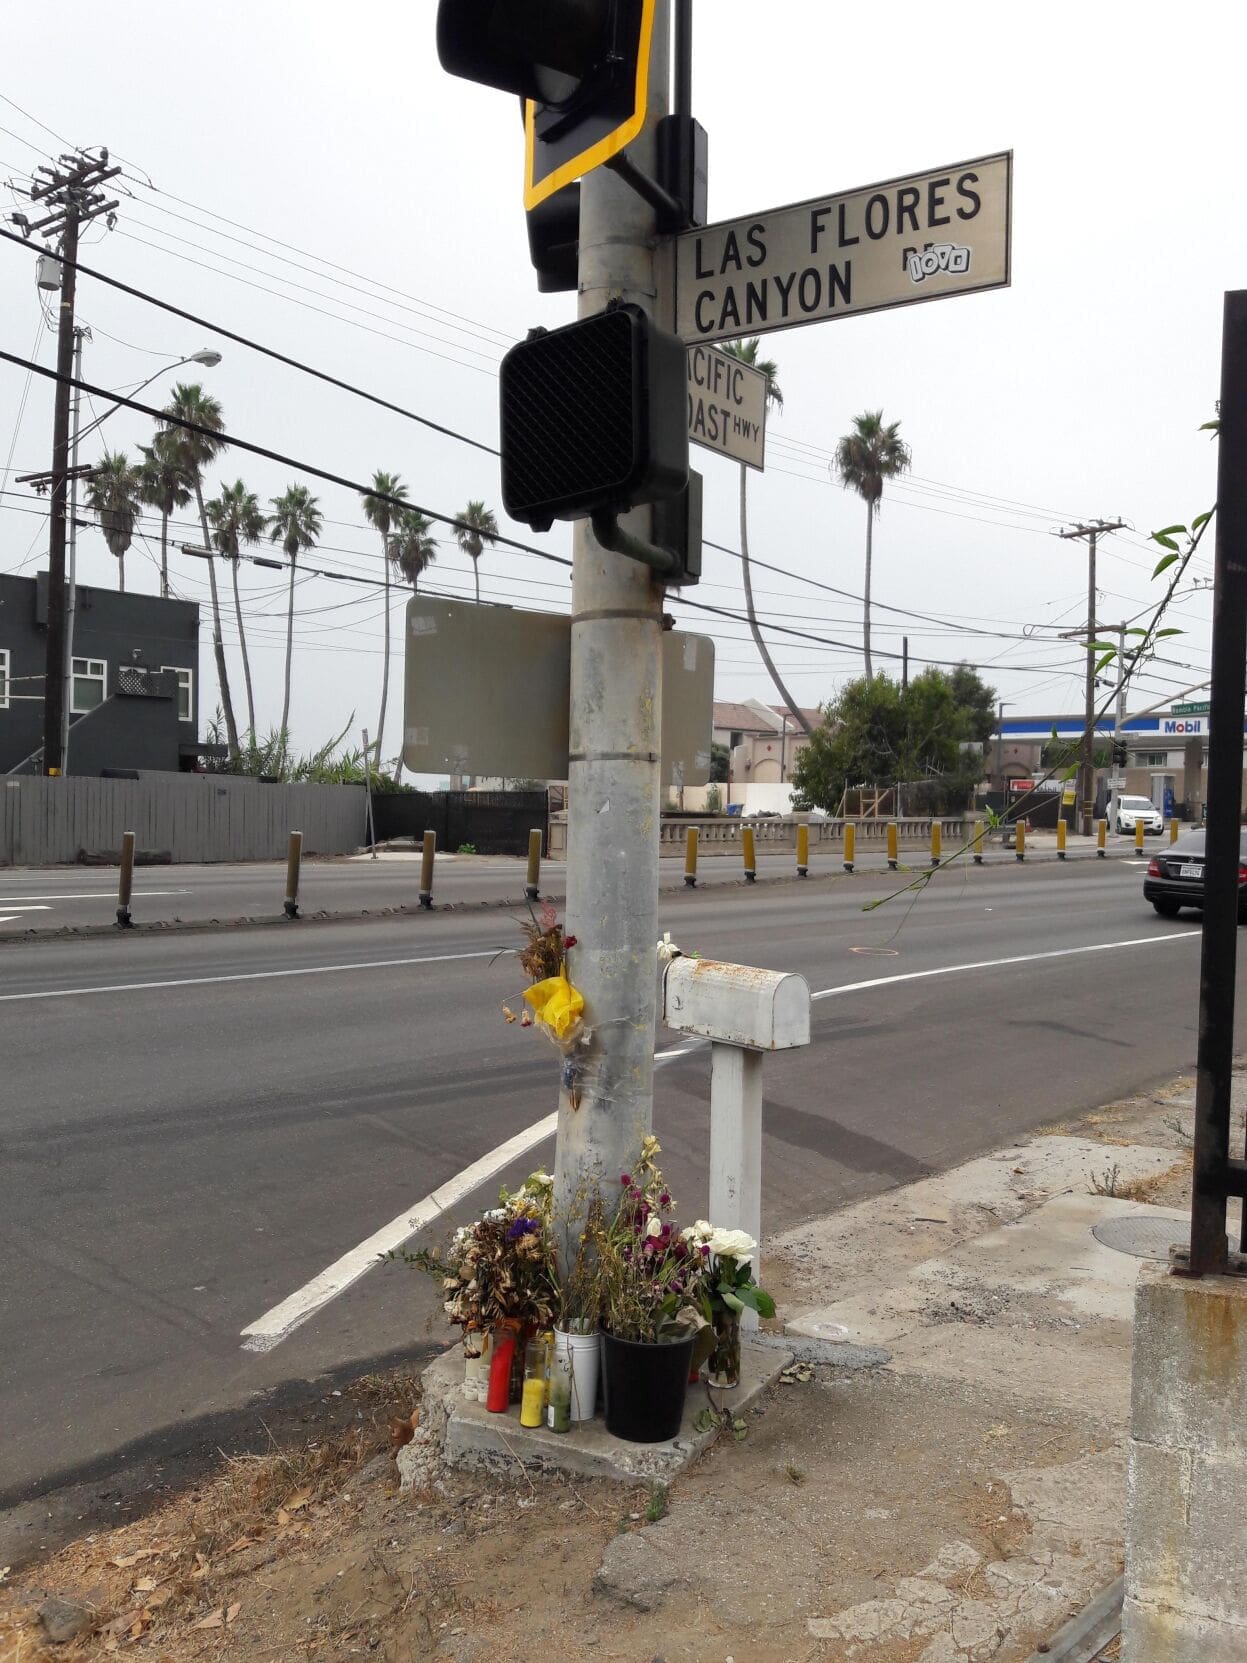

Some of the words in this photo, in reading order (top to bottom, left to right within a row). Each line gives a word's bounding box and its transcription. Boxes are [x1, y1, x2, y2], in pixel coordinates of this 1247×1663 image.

[695, 223, 767, 280] LAS
[810, 172, 982, 254] FLORES
[694, 260, 852, 334] CANYON
[688, 347, 744, 406] CIFIC
[688, 392, 731, 447] AST
[733, 414, 760, 442] HWY
[1164, 720, 1201, 733] Mobil
